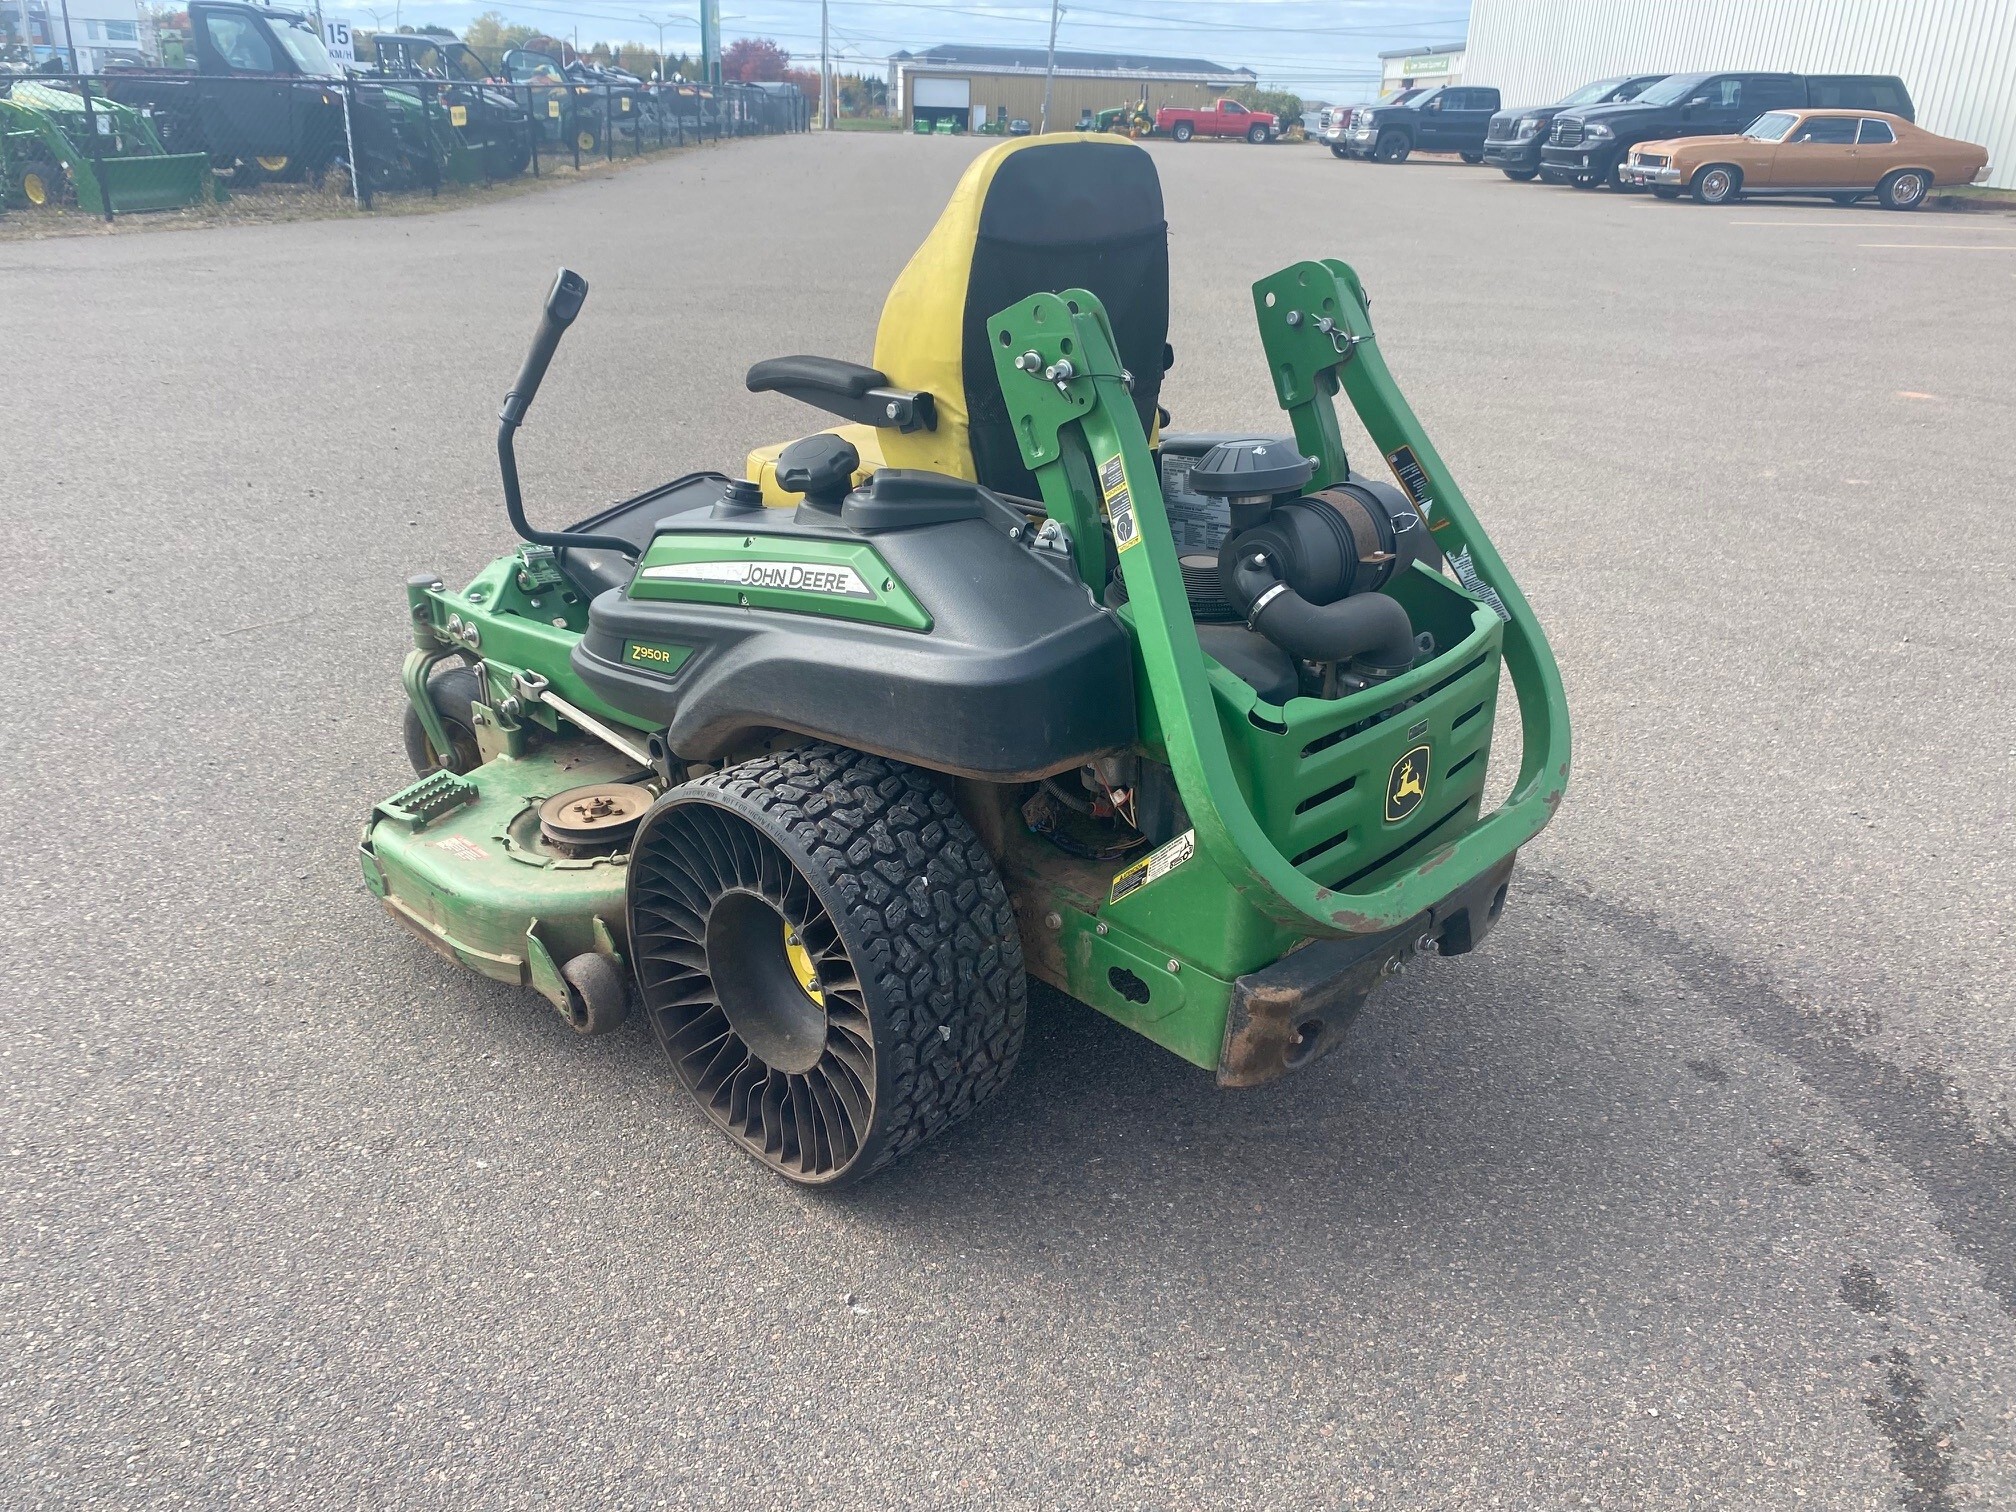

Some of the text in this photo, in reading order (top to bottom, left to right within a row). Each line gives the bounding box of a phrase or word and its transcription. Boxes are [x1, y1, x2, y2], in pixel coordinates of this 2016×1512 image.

[327, 23, 349, 45] 15
[328, 49, 353, 60] KM/H
[741, 563, 849, 591] JOHN DEERE
[632, 645, 670, 663] Z950R
[722, 796, 734, 805] NOT
[734, 801, 748, 812] FOR
[748, 809, 774, 831] HIGHWAY
[773, 828, 788, 845] USE
